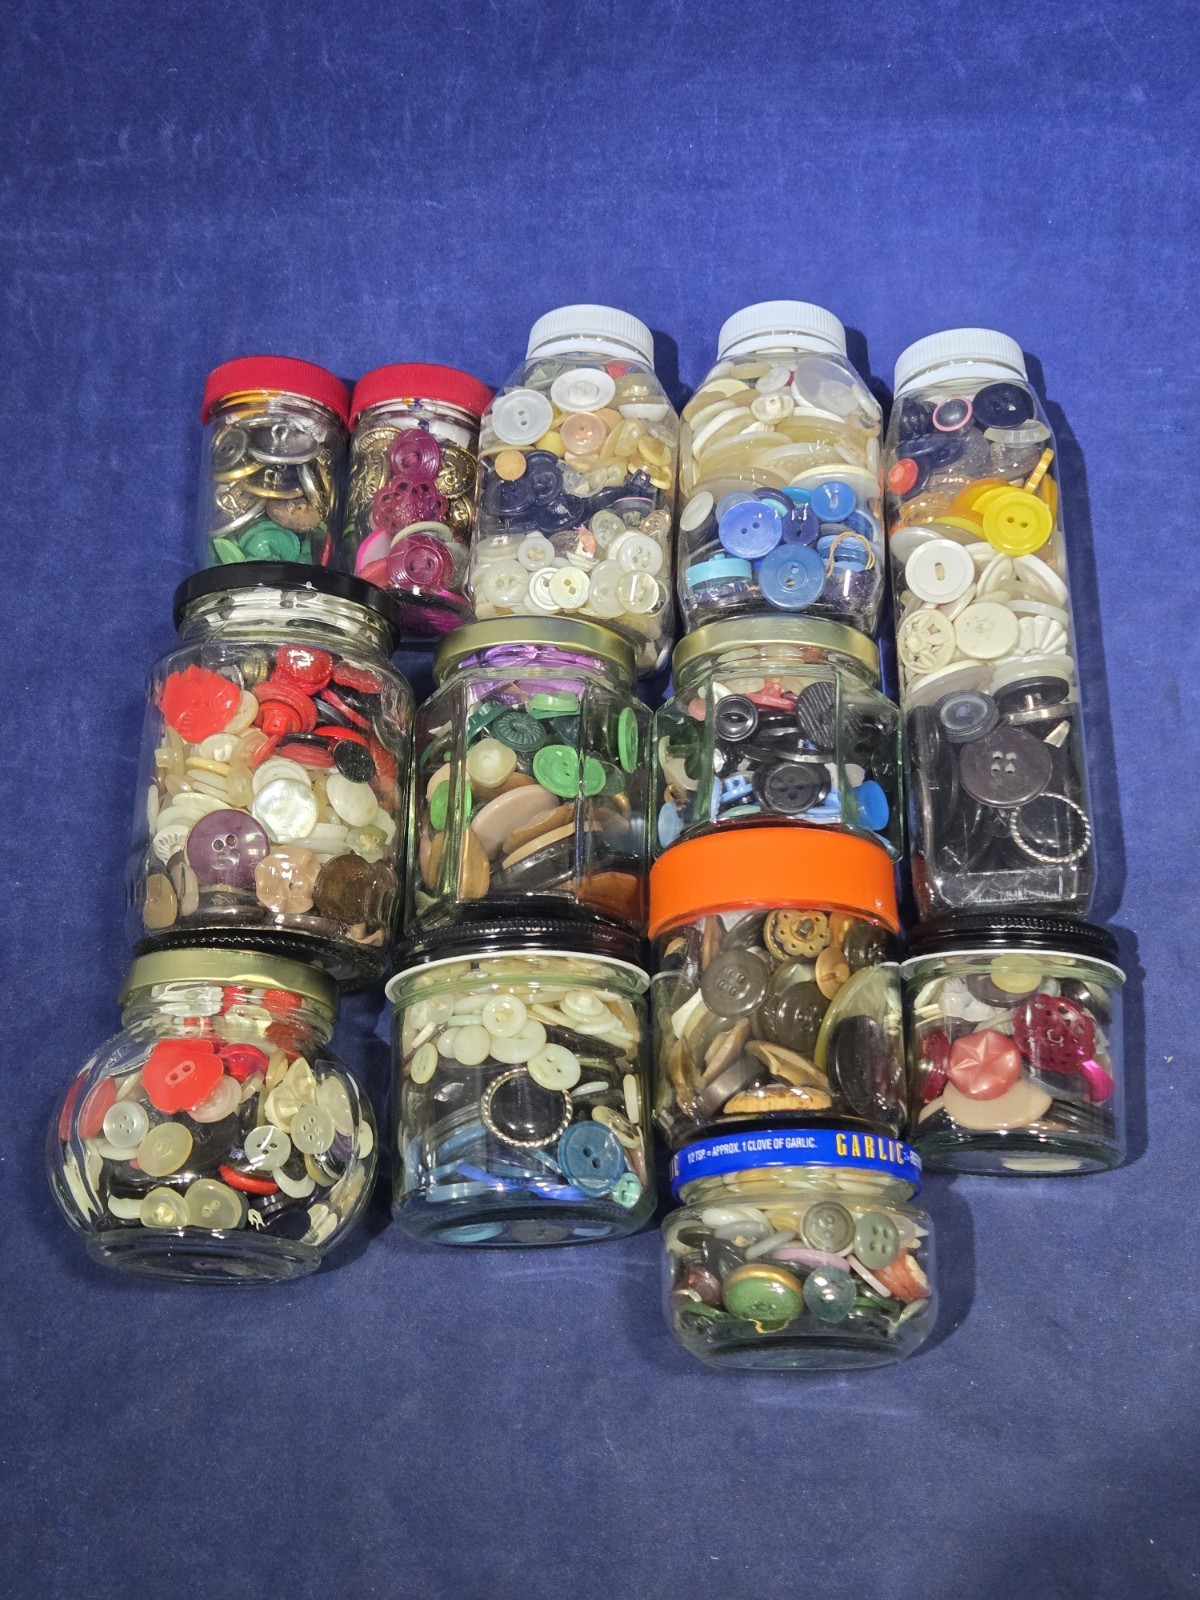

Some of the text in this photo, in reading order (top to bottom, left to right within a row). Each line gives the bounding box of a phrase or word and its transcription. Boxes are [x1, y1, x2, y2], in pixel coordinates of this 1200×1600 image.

[712, 1142, 741, 1157] APPROX.
[748, 1139, 772, 1152] CLOVE
[773, 1138, 784, 1149] OF
[785, 1137, 817, 1149] GARLIC.
[835, 1133, 904, 1165] GARLIC
